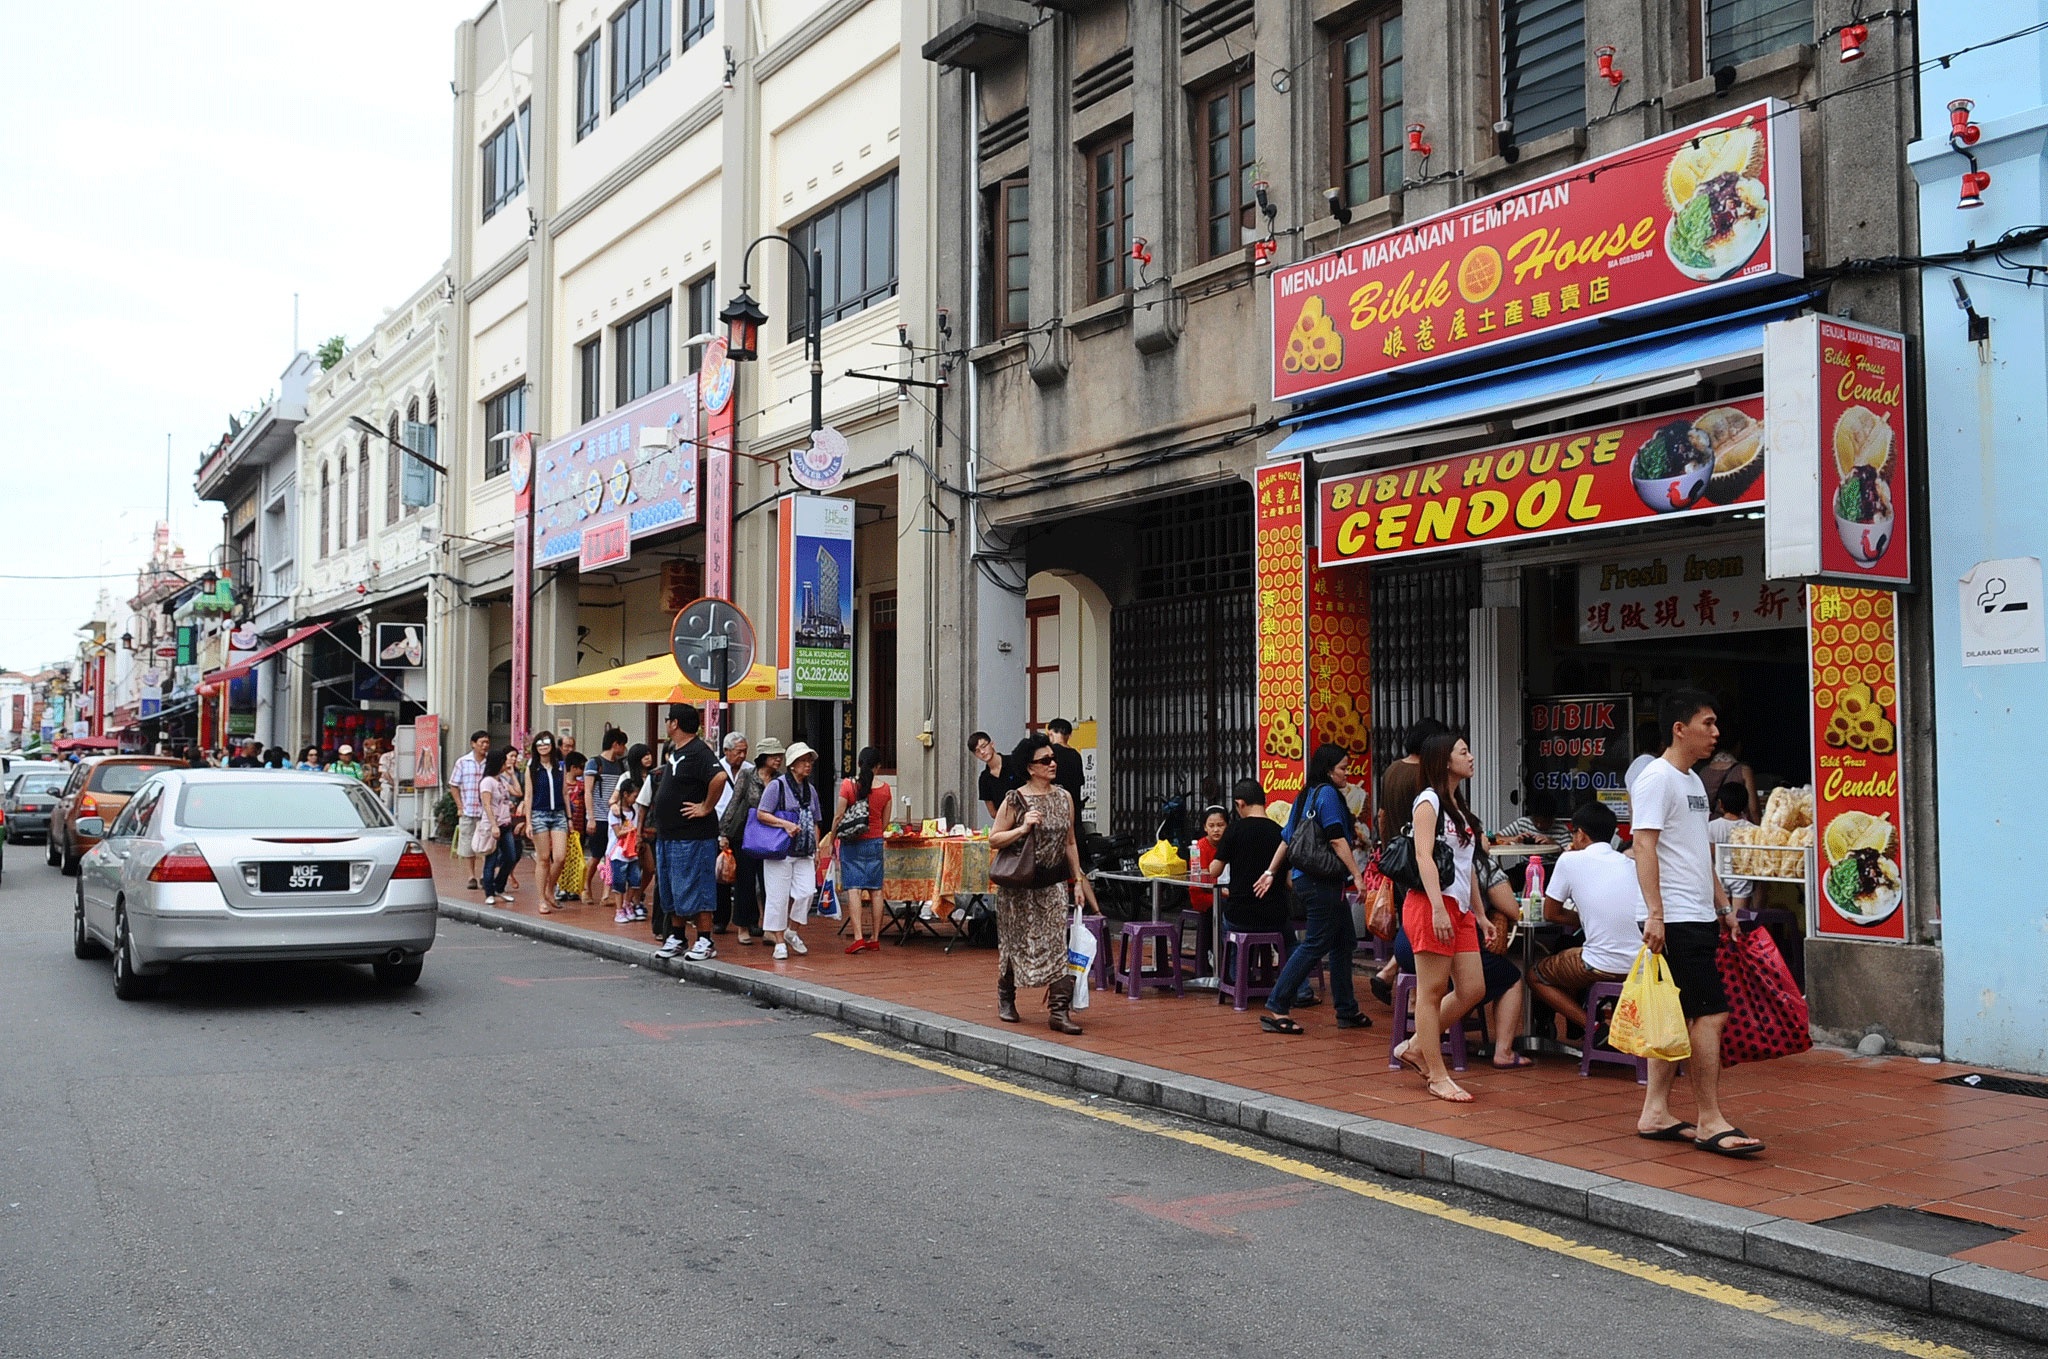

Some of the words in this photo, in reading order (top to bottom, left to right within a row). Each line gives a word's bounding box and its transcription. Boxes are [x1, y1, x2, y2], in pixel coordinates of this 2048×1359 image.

[1281, 253, 1358, 298] MENJUAL
[1362, 218, 1455, 270] MAKANAN
[1459, 181, 1570, 237] TEMPATAN
[1347, 259, 1453, 331] Bibik
[1507, 216, 1656, 286] House
[1821, 322, 1847, 341] MENJUAL
[1847, 330, 1874, 347] MAKANAN
[1873, 335, 1900, 353] TEMPATAN
[1824, 346, 1851, 368] Bibik
[1855, 354, 1886, 375] House
[1837, 370, 1900, 407] Cendol
[1278, 471, 1301, 483] HOUSE
[1330, 463, 1449, 511] BIBIK
[1461, 429, 1625, 488] HOUSE
[1336, 473, 1602, 556] CENDOL
[1600, 558, 1669, 592] Fresh
[1683, 553, 1745, 583] from
[1966, 649, 2002, 658] DILARANG
[2003, 646, 2040, 655] MEROKOK
[796, 666, 826, 681] 06.282
[828, 667, 849, 682] 2666
[1532, 702, 1616, 731] BIBIK
[1540, 737, 1606, 757] HOUSE
[1842, 754, 1866, 767] House
[1263, 769, 1304, 794] Cendol
[1534, 770, 1620, 791] CENDOL
[1824, 768, 1897, 802] Cendol
[288, 875, 324, 888] 5577
[292, 864, 319, 876] WGF
